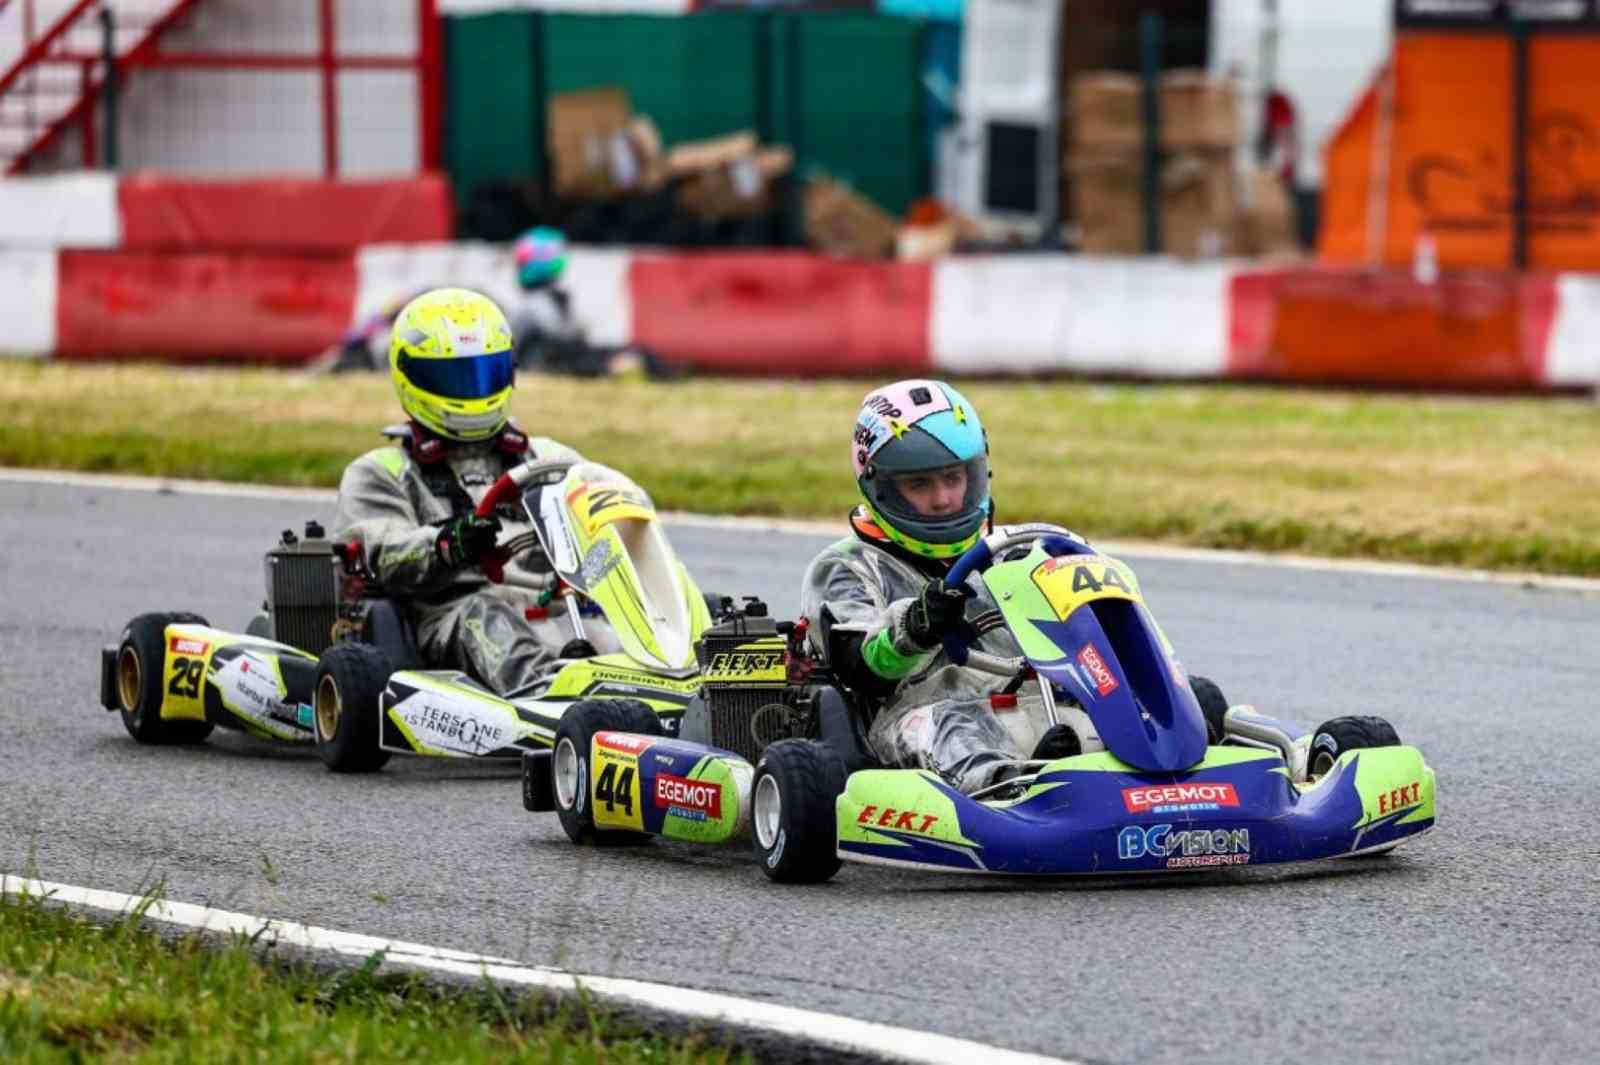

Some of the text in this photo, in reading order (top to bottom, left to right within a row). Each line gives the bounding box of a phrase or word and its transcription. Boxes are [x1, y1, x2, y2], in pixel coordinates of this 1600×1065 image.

[1072, 566, 1133, 594] 44
[169, 656, 204, 699] 29
[595, 762, 635, 817] 44
[658, 779, 716, 808] EGEMOT
[1129, 786, 1228, 805] EGEMOT
